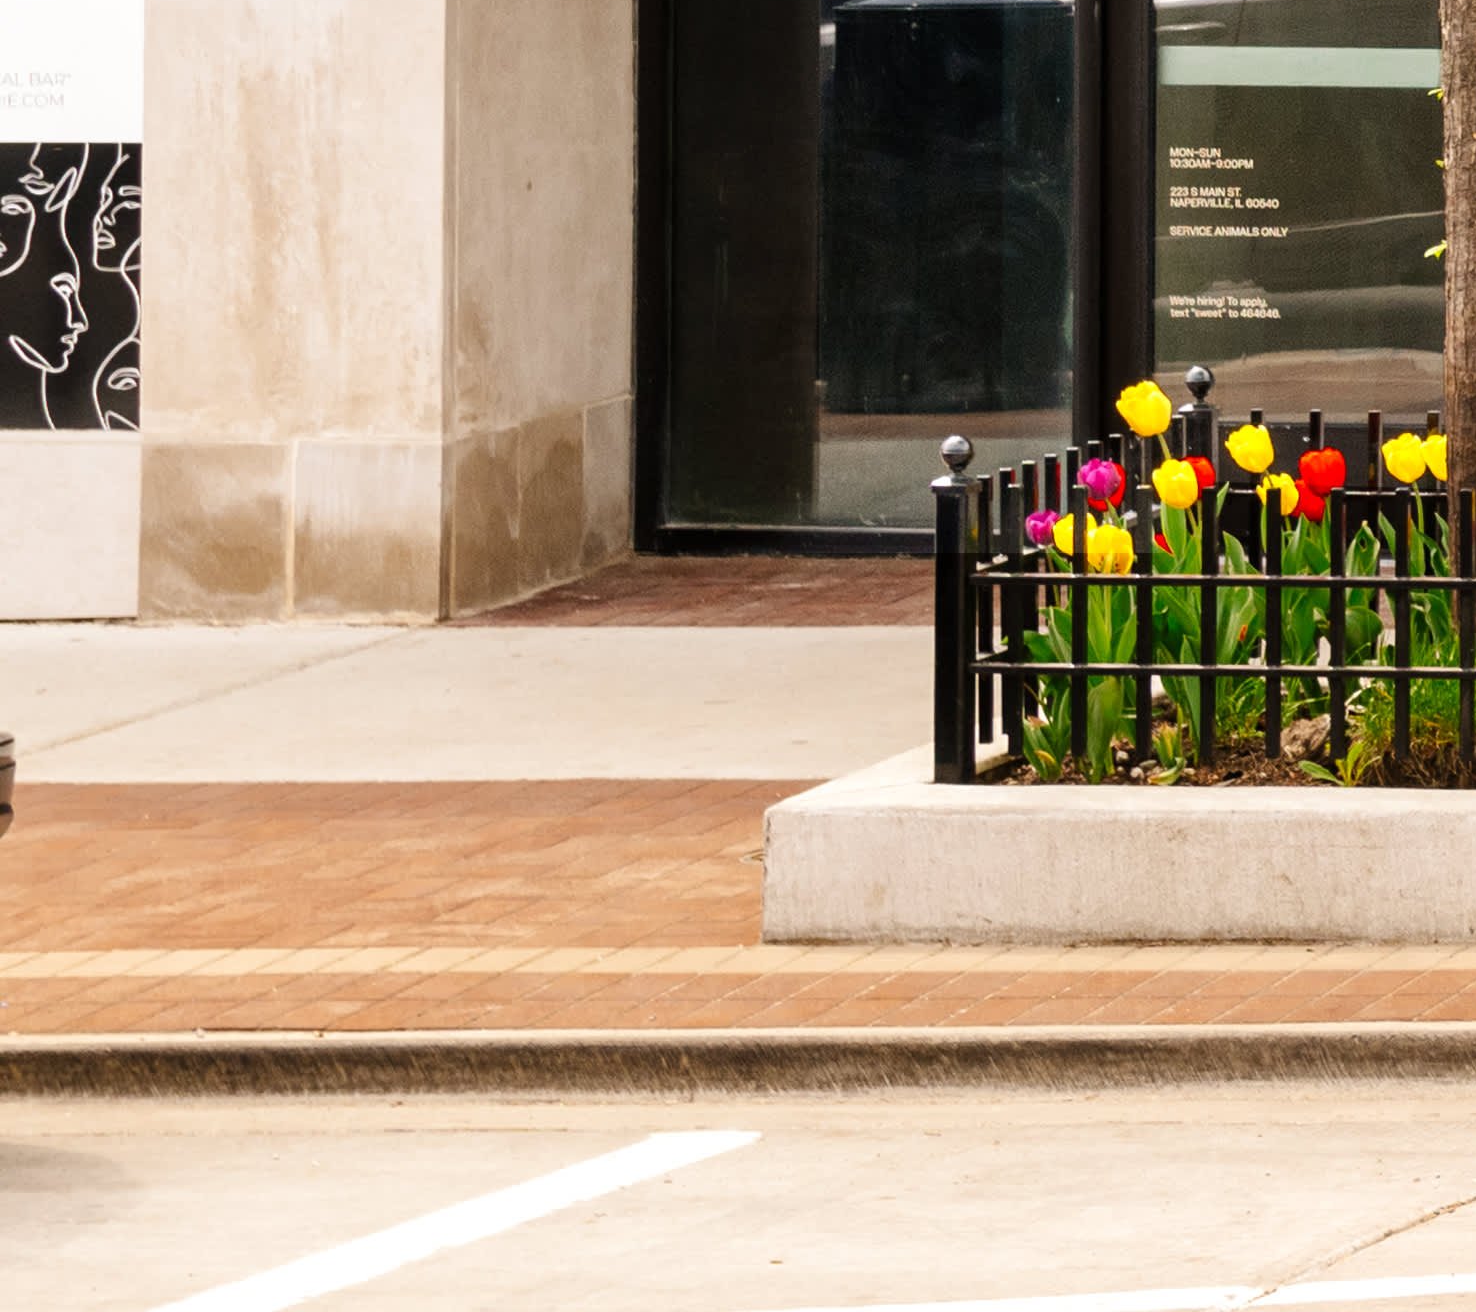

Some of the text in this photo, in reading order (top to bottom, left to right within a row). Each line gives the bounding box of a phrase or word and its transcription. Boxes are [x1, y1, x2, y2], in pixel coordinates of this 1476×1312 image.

[1169, 186, 1242, 196] 223 S MAIN ST.
[1169, 198, 1234, 208] NAPERVILLE,
[1235, 198, 1245, 208] IL
[1169, 226, 1289, 236] SERVICE ANIMALS ONLY
[1226, 295, 1239, 305] To
[1228, 309, 1239, 318] to
